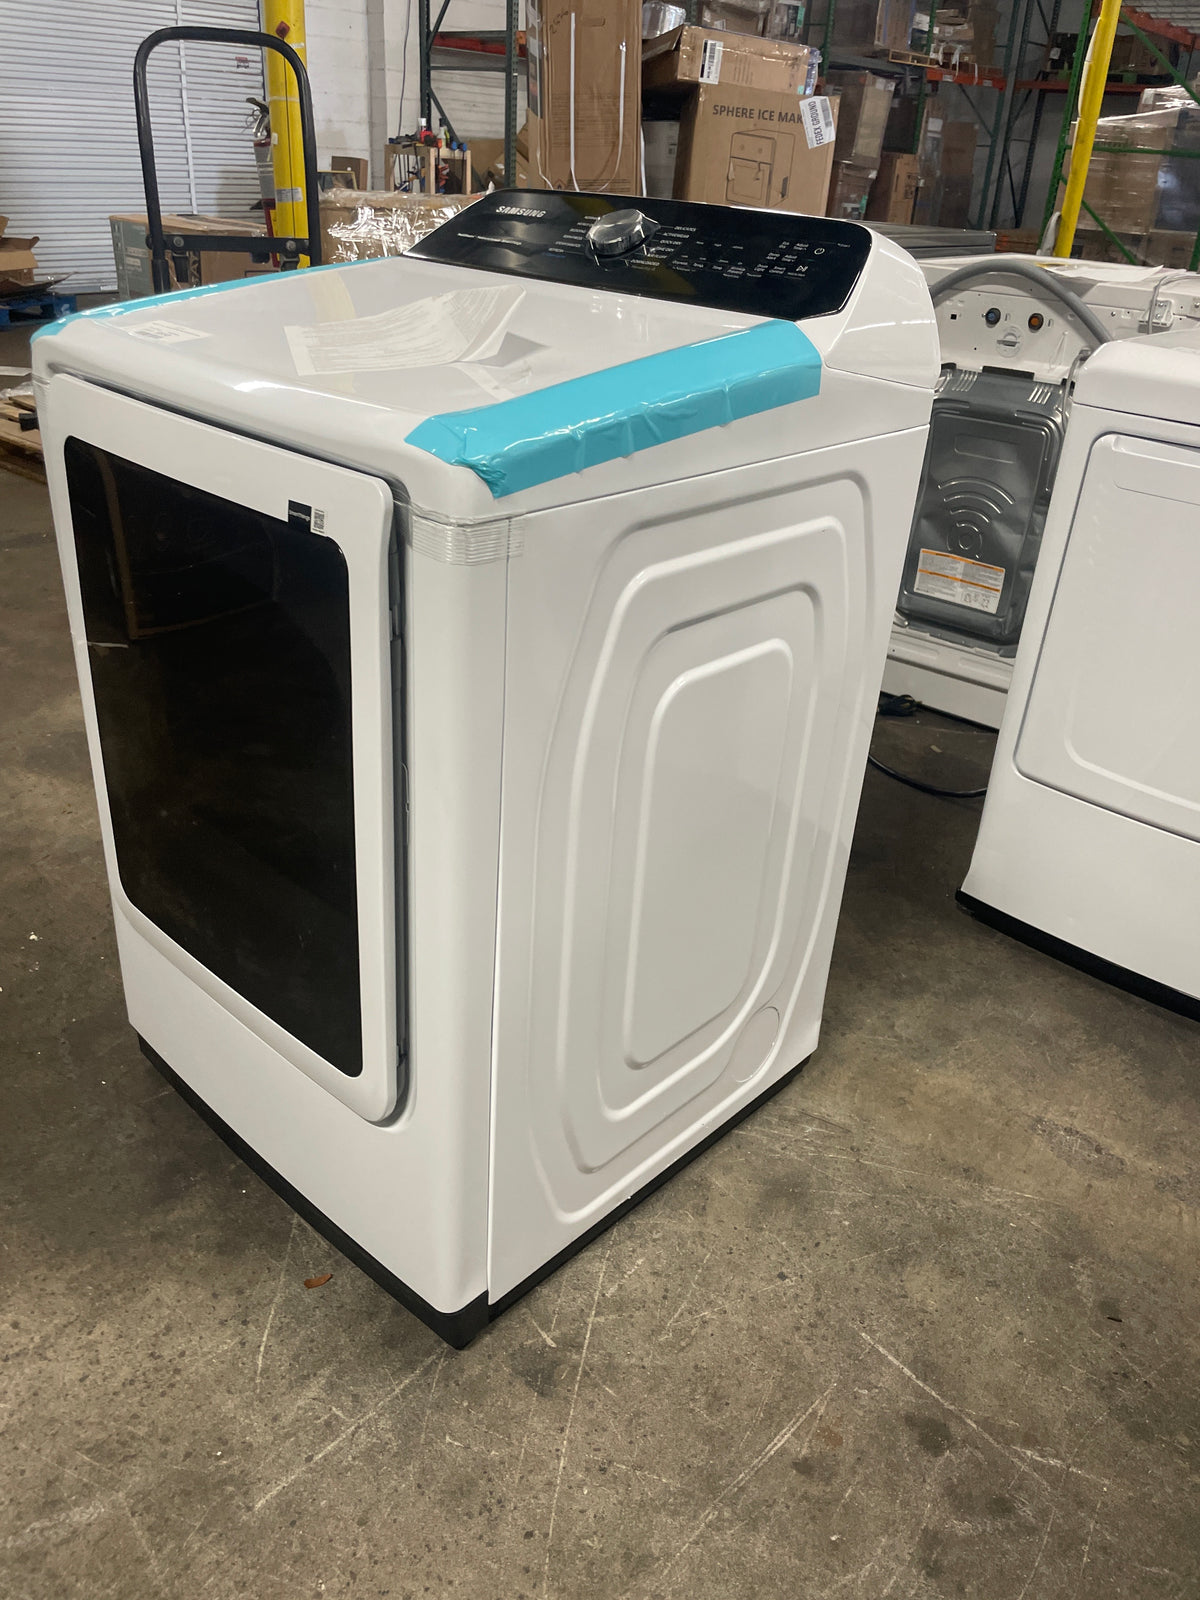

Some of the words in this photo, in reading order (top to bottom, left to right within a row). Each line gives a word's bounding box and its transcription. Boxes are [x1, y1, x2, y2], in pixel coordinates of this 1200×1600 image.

[713, 105, 755, 119] SPHERE
[758, 109, 775, 120] ICE
[807, 101, 821, 126] GROUND
[813, 126, 824, 145] FEDEX
[495, 205, 547, 218] SAMSUNG
